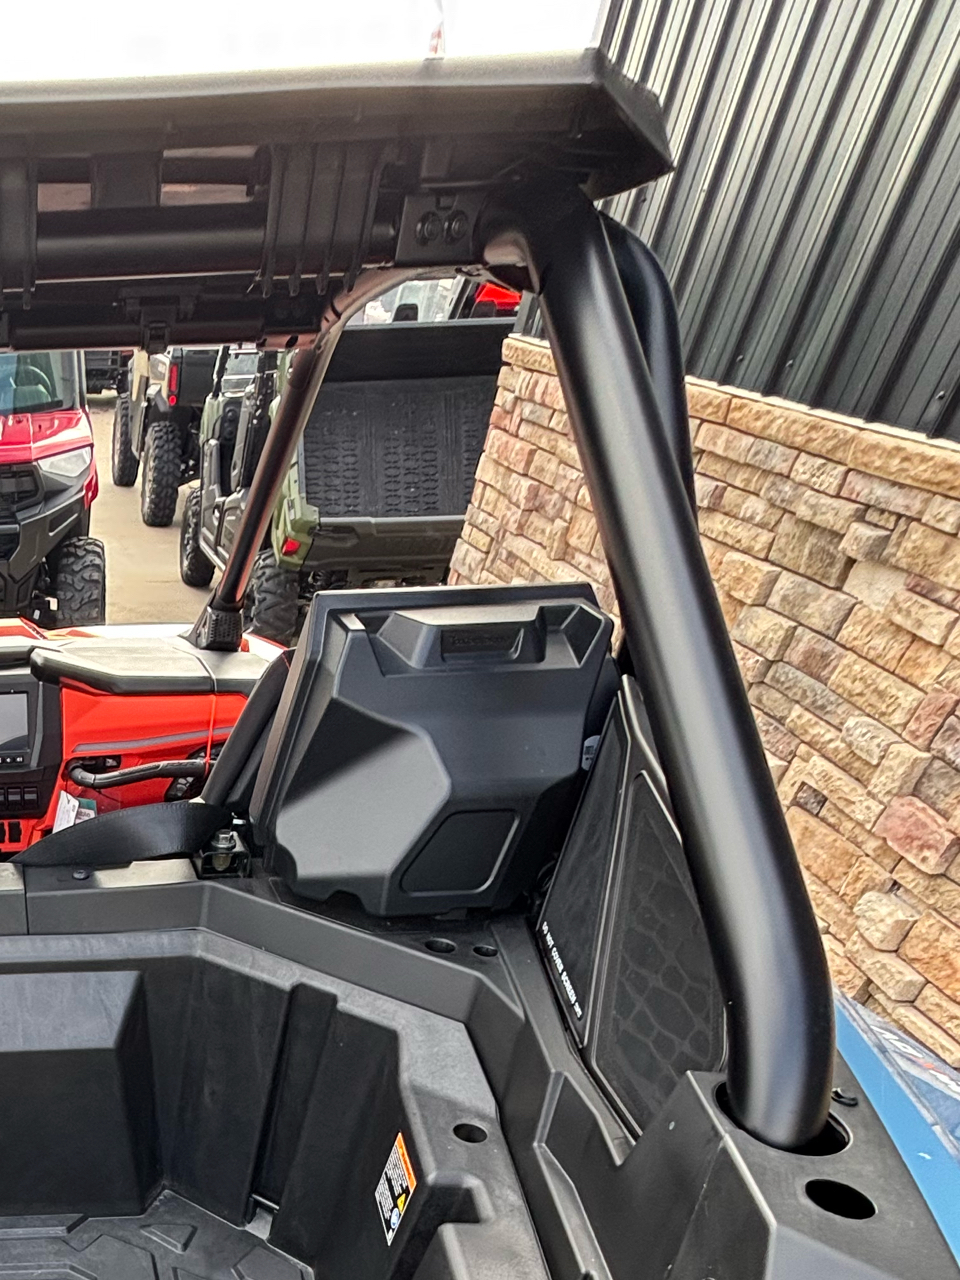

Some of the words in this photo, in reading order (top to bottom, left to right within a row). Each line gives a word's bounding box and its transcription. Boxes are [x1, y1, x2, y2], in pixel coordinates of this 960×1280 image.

[542, 921, 549, 935] DO
[546, 932, 555, 949] NOT
[551, 947, 564, 974] COVER
[561, 971, 577, 1005] SCREEN
